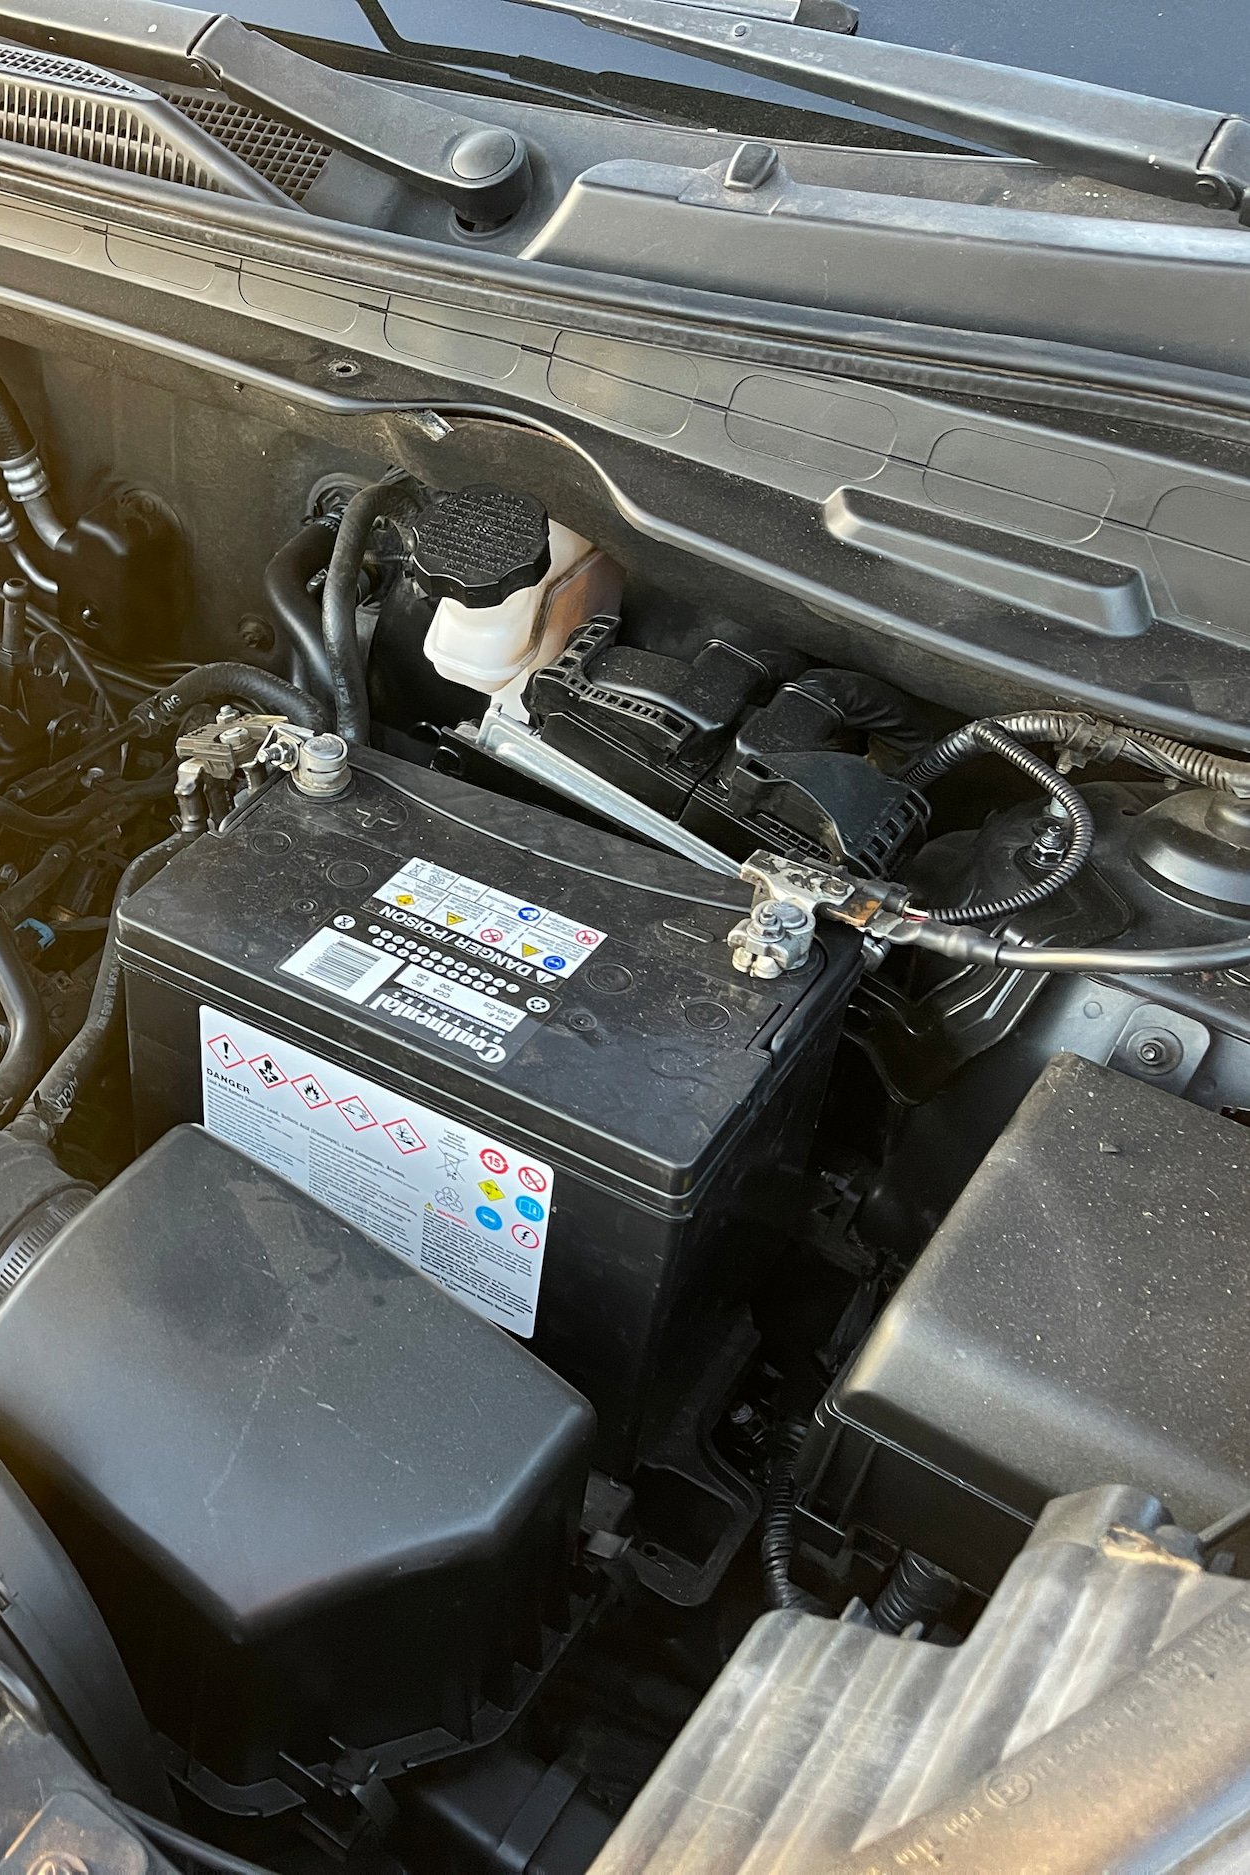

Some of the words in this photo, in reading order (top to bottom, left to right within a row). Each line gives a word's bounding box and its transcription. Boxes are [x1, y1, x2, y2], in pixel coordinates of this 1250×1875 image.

[454, 936, 534, 975] DANGER
[410, 978, 425, 987] RC
[431, 987, 450, 998] CCA
[439, 982, 454, 991] 700
[391, 989, 502, 1044] BATTERIES
[367, 992, 506, 1066] Continental
[206, 1067, 250, 1094] DANGER
[487, 1153, 500, 1169] 15
